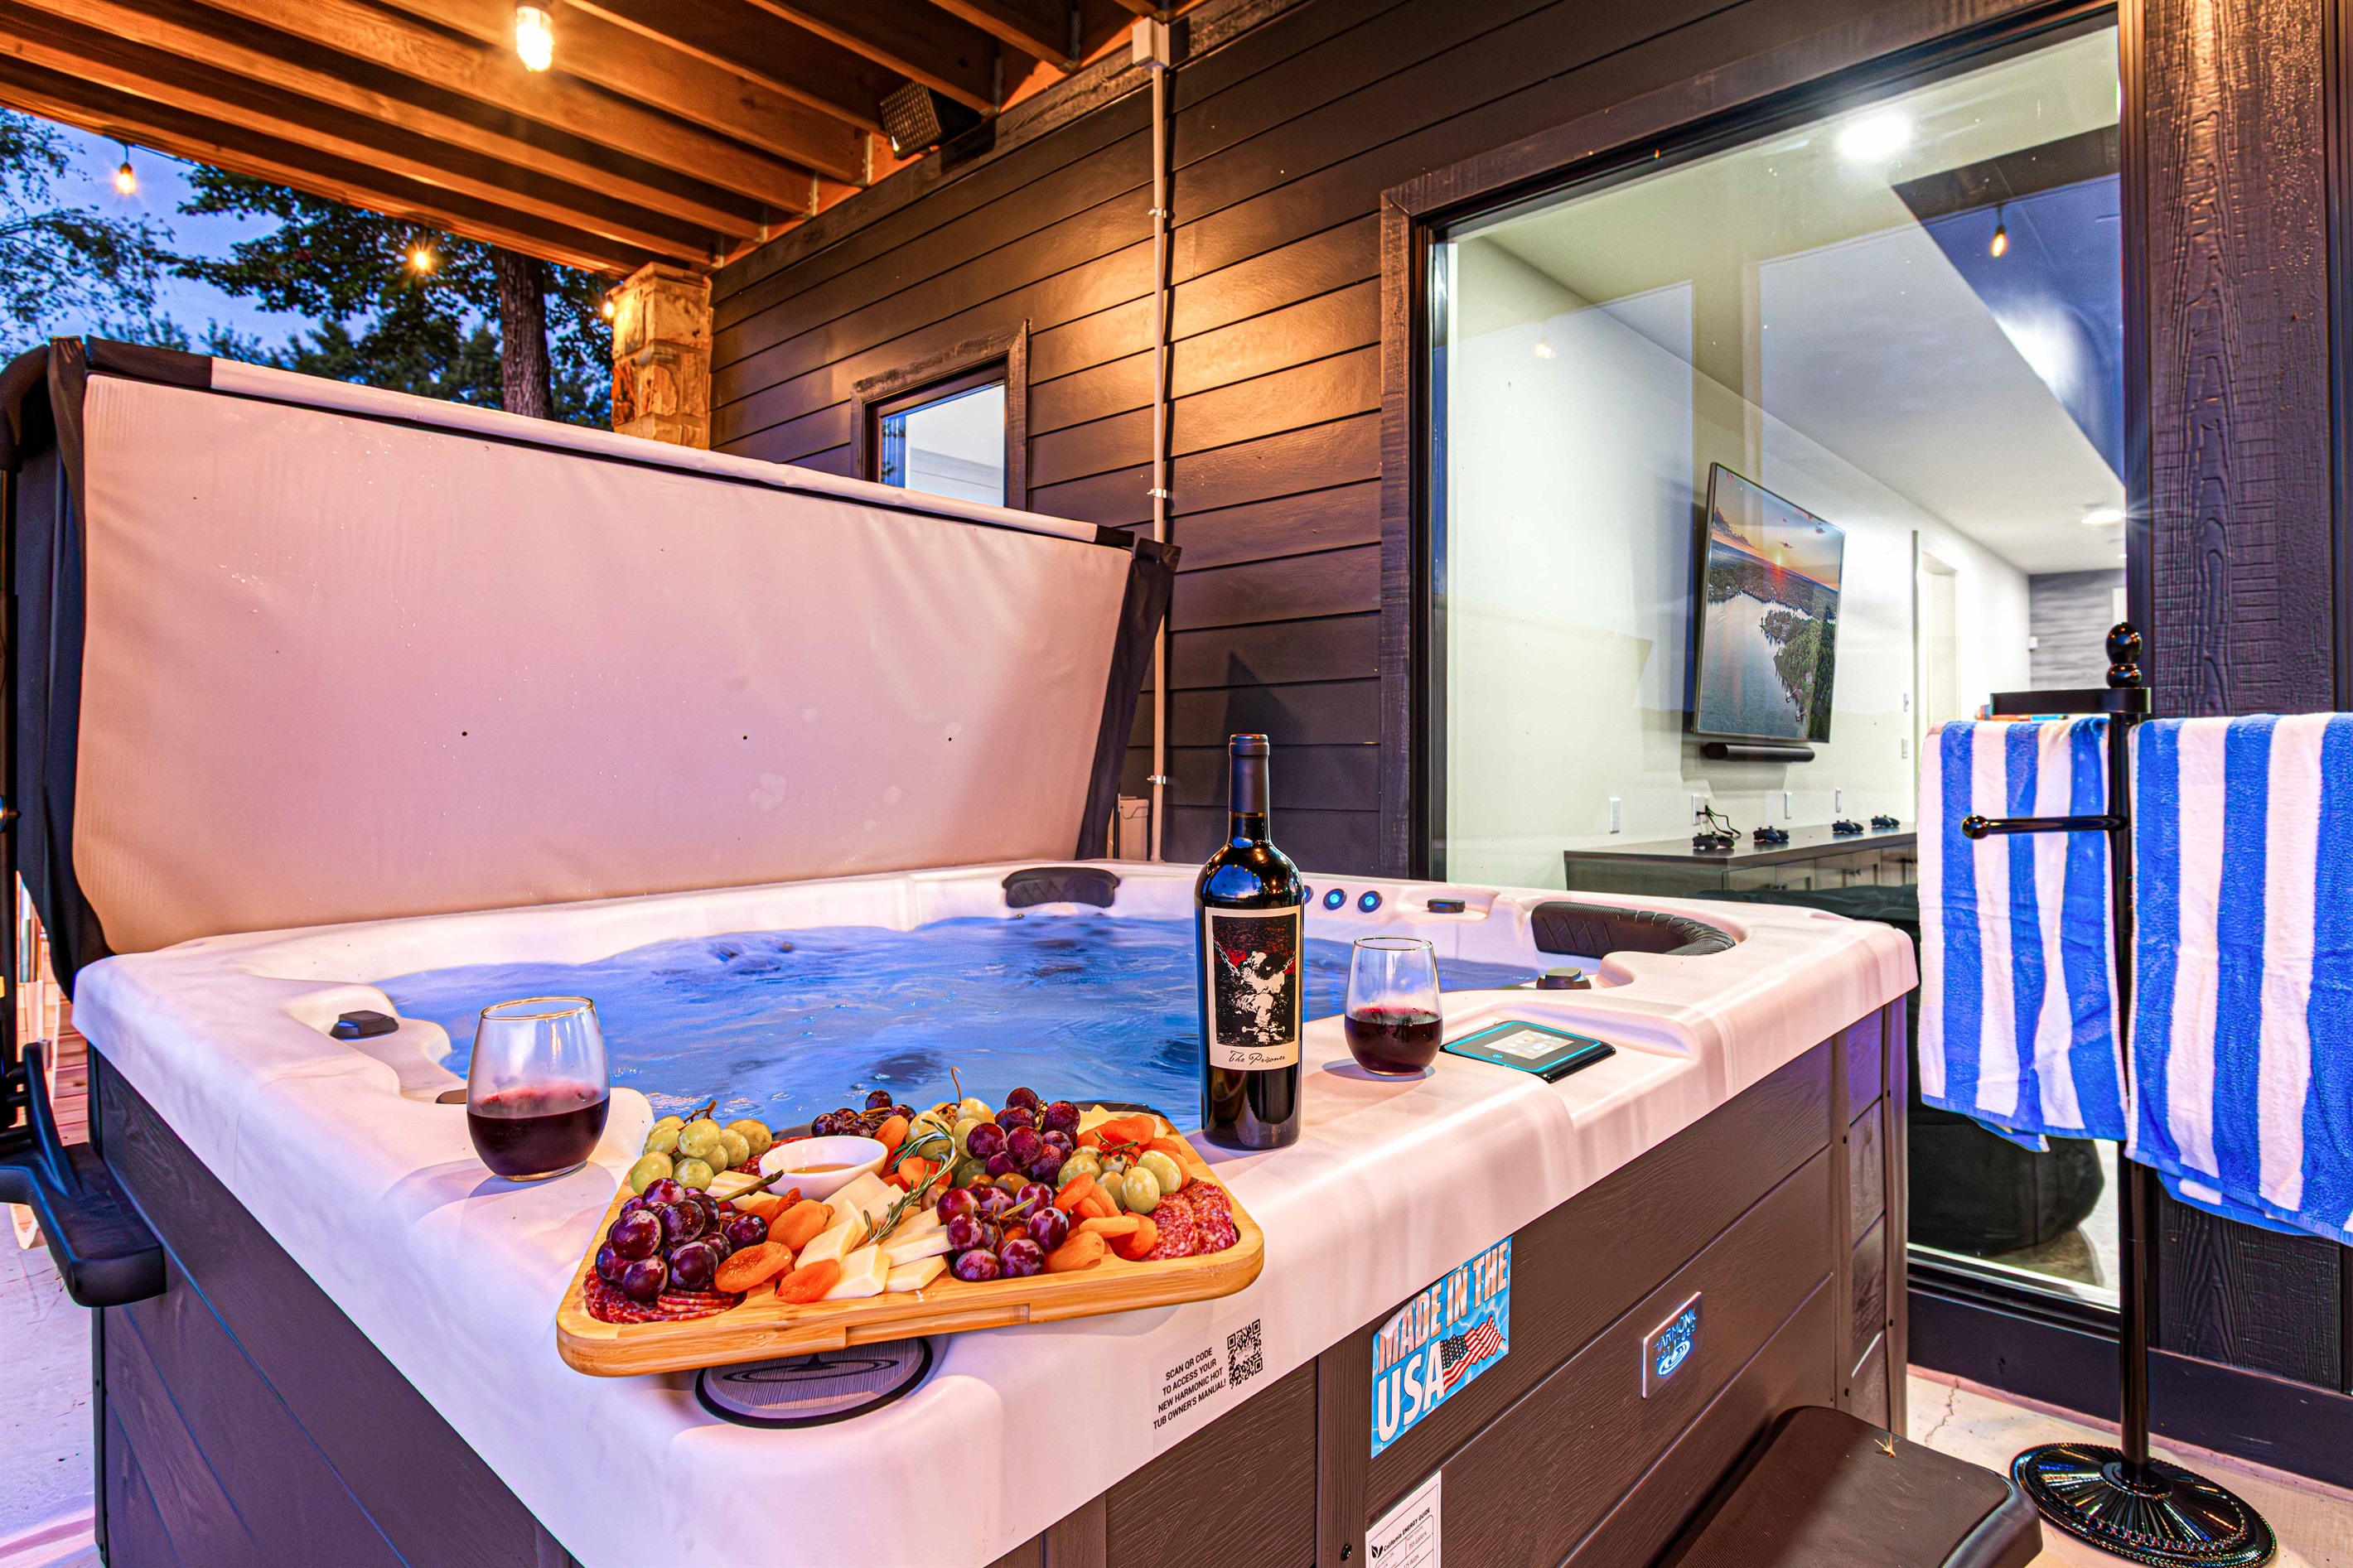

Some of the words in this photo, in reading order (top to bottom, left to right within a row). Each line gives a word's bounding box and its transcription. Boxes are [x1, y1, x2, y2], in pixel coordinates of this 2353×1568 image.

[1229, 1049, 1245, 1063] The
[1249, 1052, 1285, 1065] Prisoner
[1378, 1281, 1442, 1376] MADE
[1446, 1265, 1469, 1329] IN
[1472, 1240, 1509, 1310] THE
[1162, 1385, 1172, 1397] TO
[1172, 1368, 1198, 1392] ACCESS
[1199, 1358, 1217, 1374] YOUR
[1166, 1363, 1184, 1381] SCAN
[1185, 1358, 1195, 1370] QR
[1196, 1347, 1213, 1363] CODE
[1152, 1415, 1167, 1430] TUB
[1167, 1397, 1197, 1421] OWNER'S
[1198, 1377, 1226, 1402] MANUAL!
[1157, 1397, 1173, 1413] NEW
[1174, 1375, 1210, 1403] HARMONIC
[1210, 1367, 1223, 1382] HOT
[1377, 1339, 1445, 1443] USA
[1384, 1533, 1402, 1551] California
[1402, 1518, 1418, 1536] ENERGY
[1418, 1507, 1431, 1522] GUIDE
